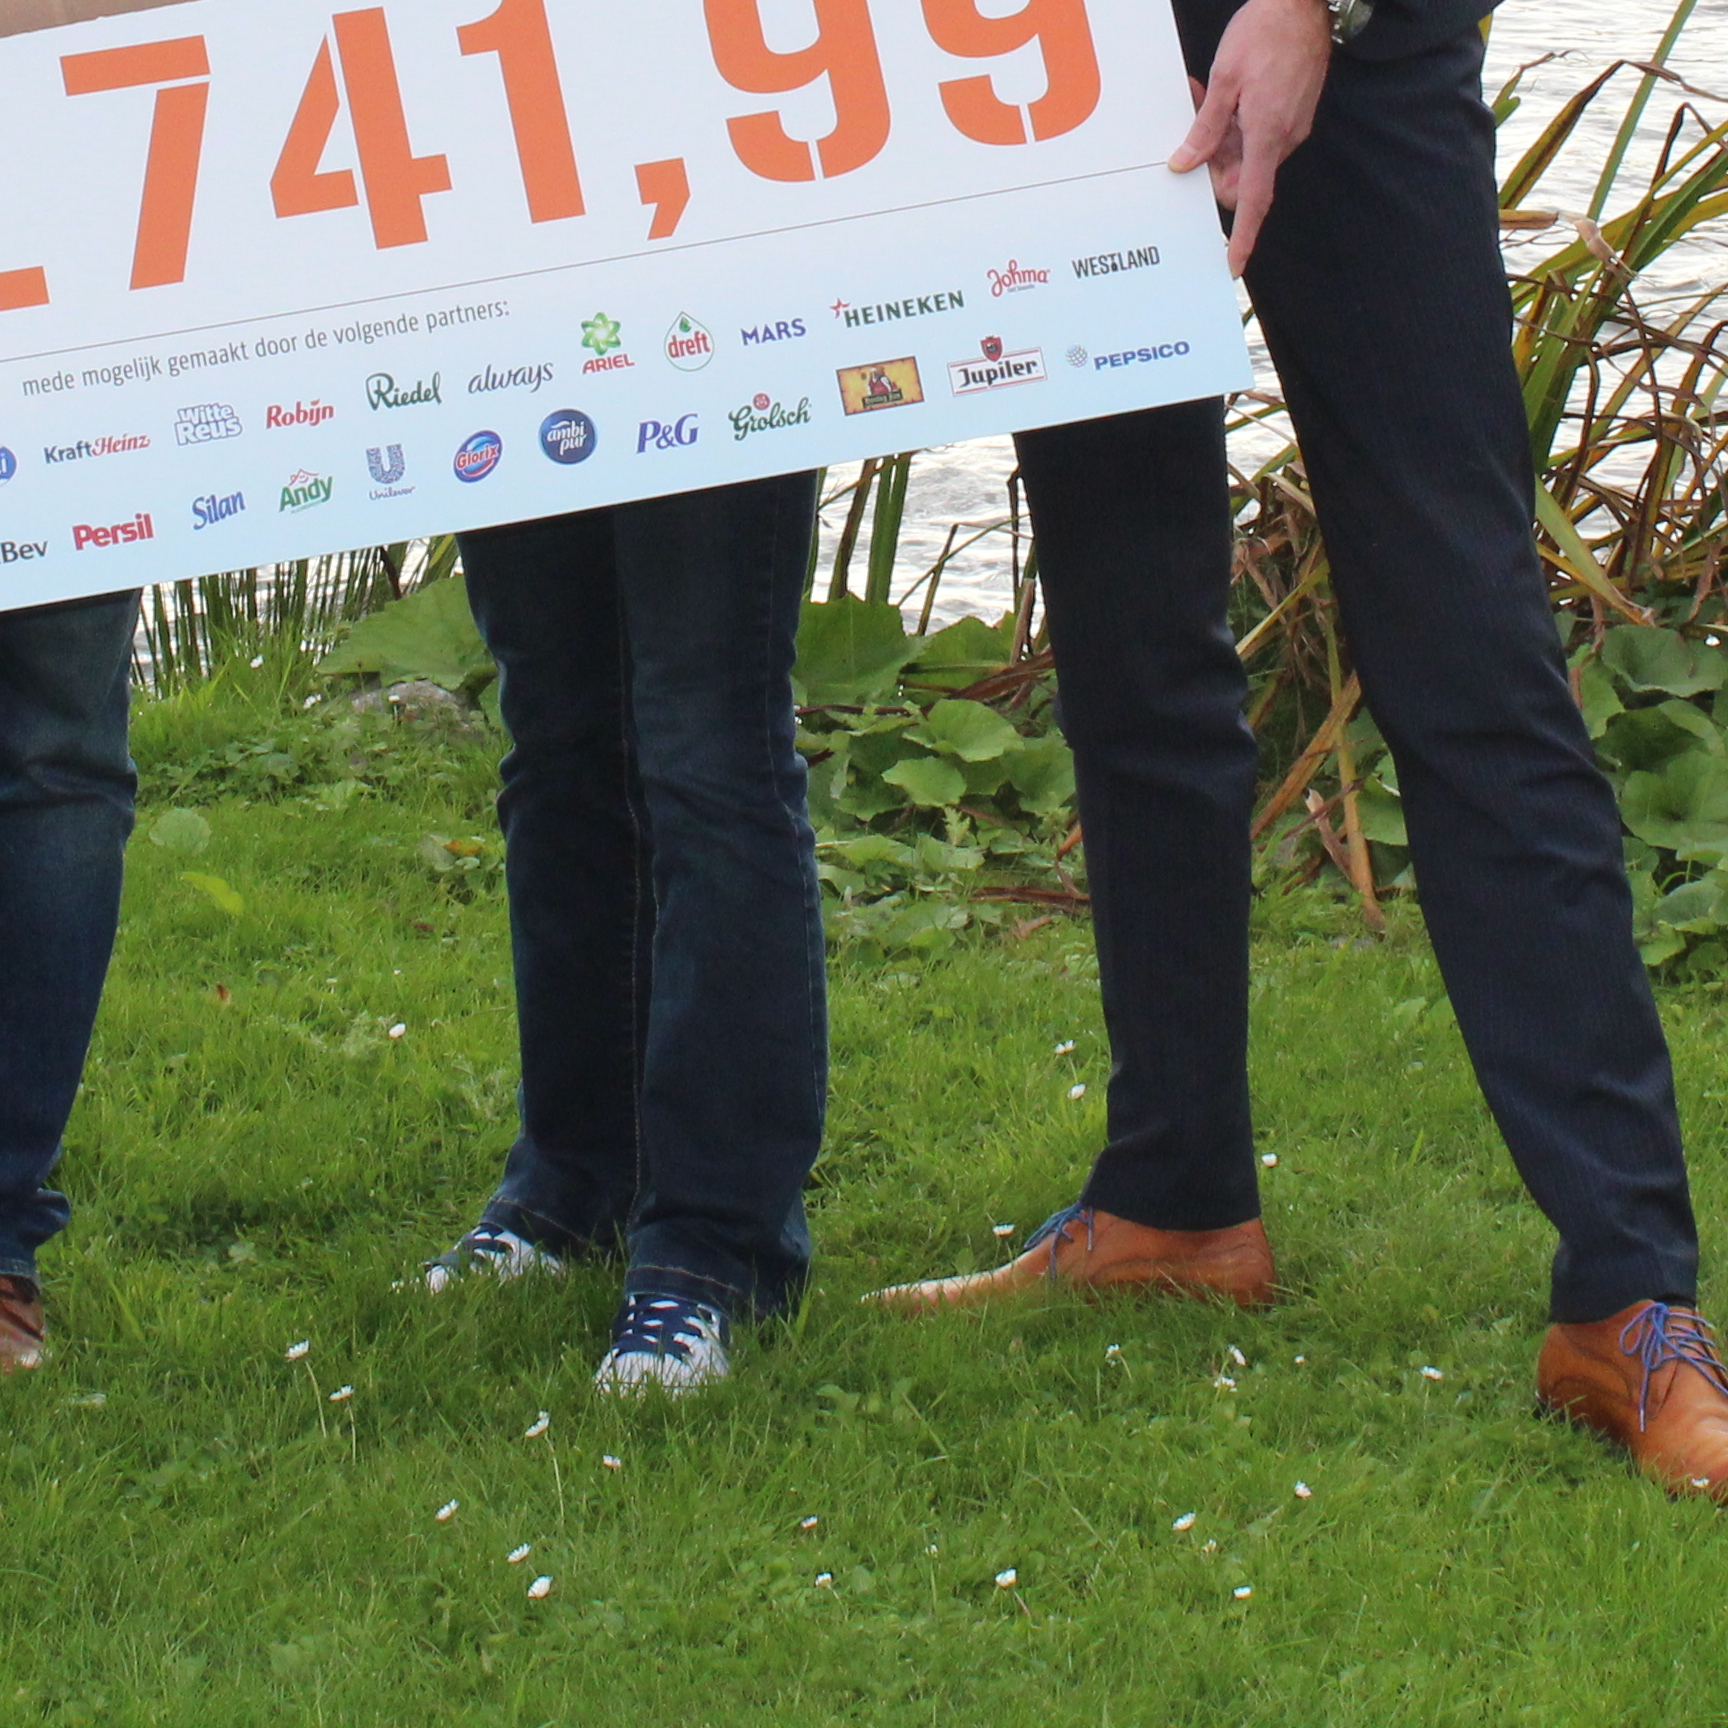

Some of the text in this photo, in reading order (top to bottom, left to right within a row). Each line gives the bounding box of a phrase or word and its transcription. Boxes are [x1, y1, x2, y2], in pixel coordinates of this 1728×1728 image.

[986, 258, 1049, 298] Johma
[1071, 245, 1161, 280] WESTLAND
[843, 289, 966, 329] HEINEKEN
[21, 298, 511, 398] mede mogelijk gemaakt door de volgende partners:
[666, 330, 711, 359] dreft
[740, 318, 807, 347] MARS
[581, 353, 636, 375] ARIEL
[1093, 340, 1191, 371] PEPSICO
[466, 361, 554, 394] always
[956, 359, 1039, 389] Jupiler
[365, 370, 443, 412] Riedel
[176, 402, 235, 426] Witte
[265, 398, 335, 430] Robijn
[727, 396, 812, 442] Grolsch
[173, 415, 244, 448] Reus
[544, 419, 587, 443] ambi
[558, 433, 588, 457] pur
[635, 413, 700, 455] P&G
[454, 442, 501, 470] Glorix
[191, 490, 248, 531] Silan
[278, 475, 334, 513] Andy
[71, 512, 155, 551] Persil
